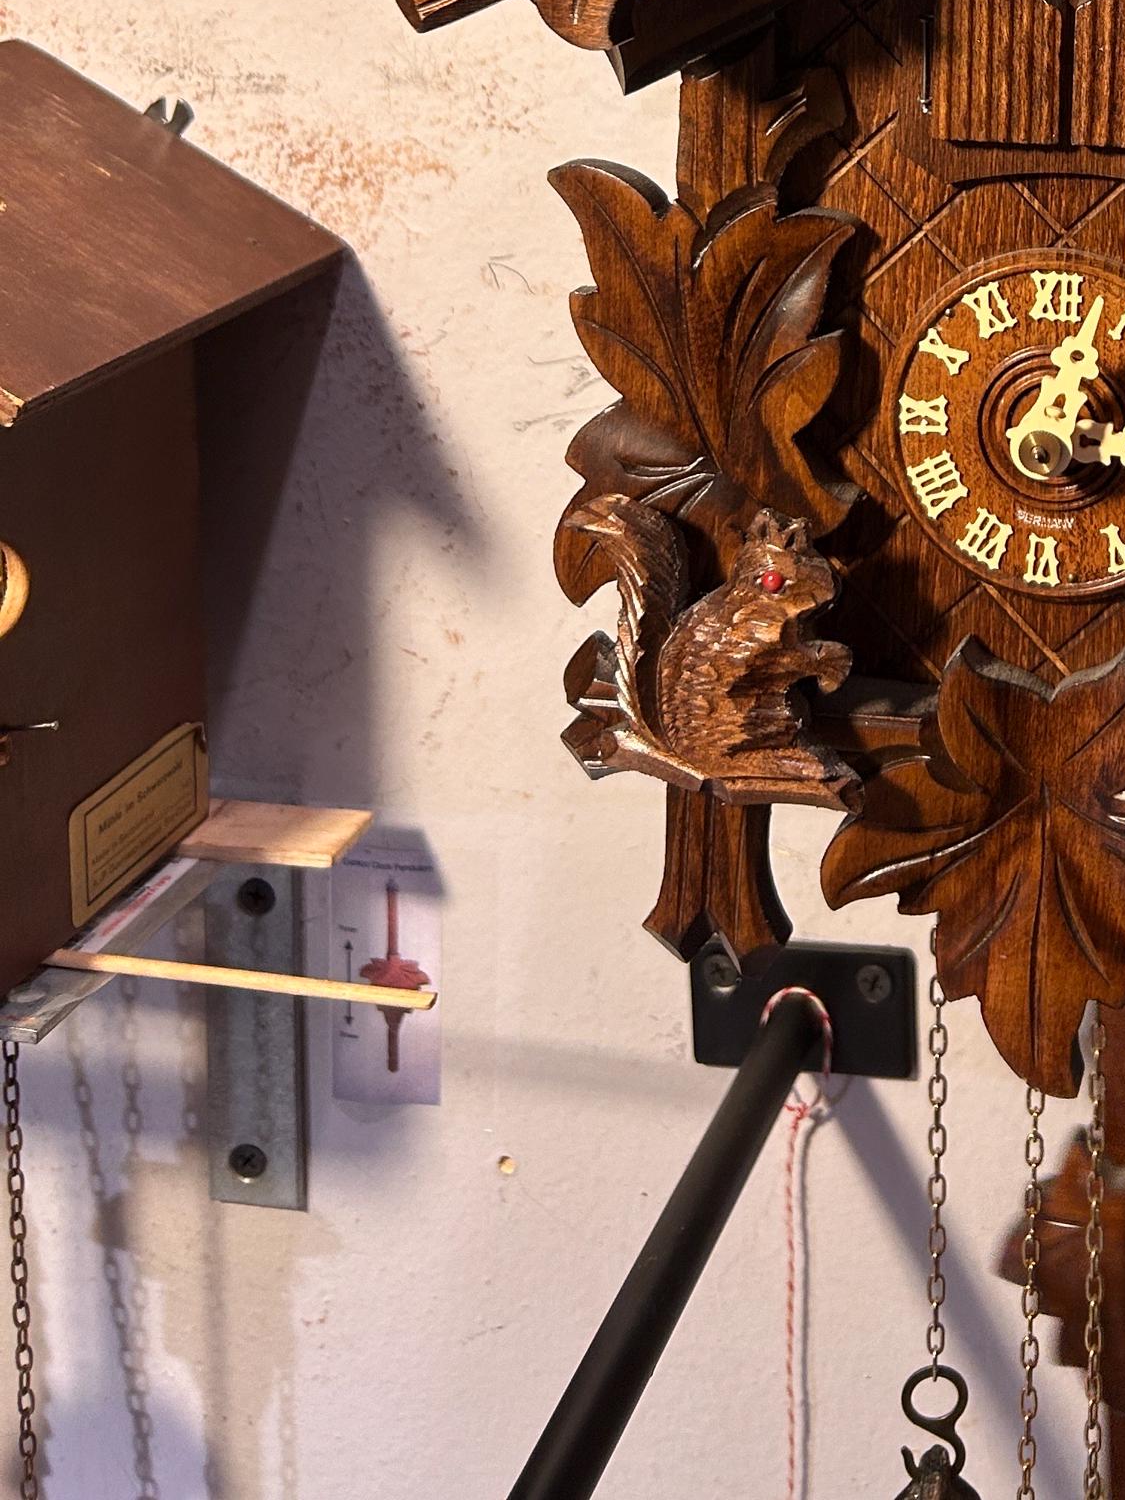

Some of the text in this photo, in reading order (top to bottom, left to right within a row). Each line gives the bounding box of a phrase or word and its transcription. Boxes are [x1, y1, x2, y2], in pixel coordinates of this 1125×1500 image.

[961, 281, 1017, 339] XI
[1029, 270, 1084, 323] XII
[918, 327, 970, 376] X
[1015, 509, 1076, 529] GERMANY
